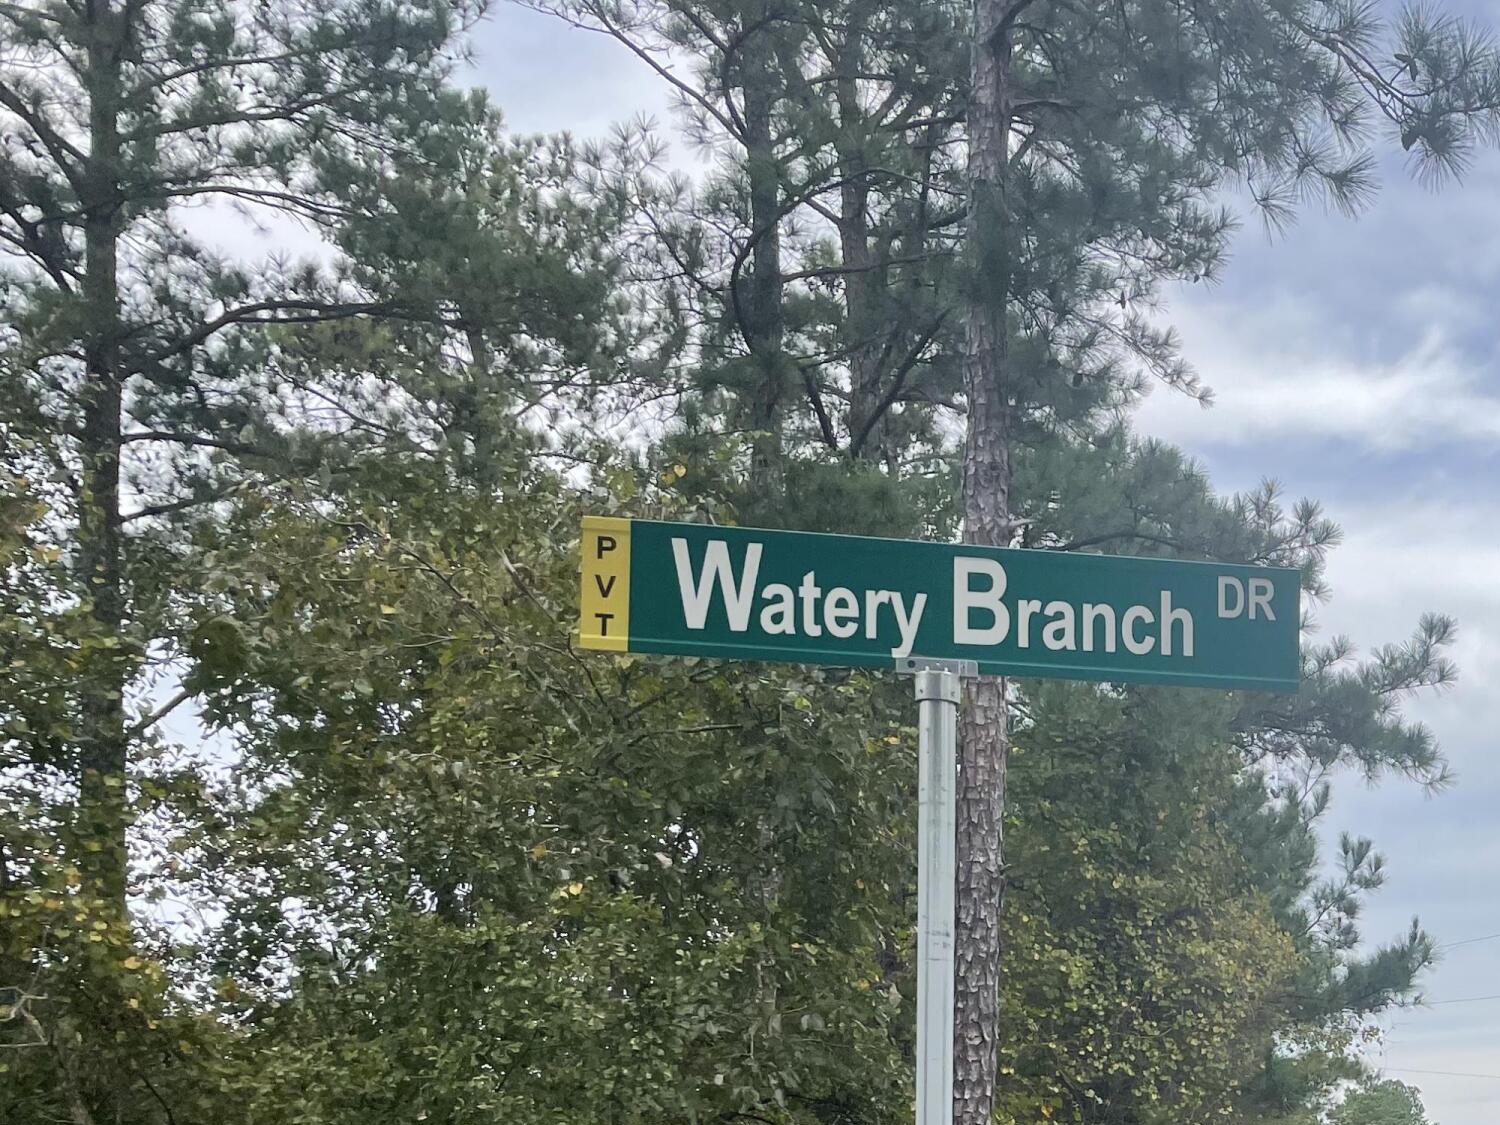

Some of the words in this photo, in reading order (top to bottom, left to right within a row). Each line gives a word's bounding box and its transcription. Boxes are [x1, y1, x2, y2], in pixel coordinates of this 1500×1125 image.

[595, 535, 618, 637] PVT
[670, 537, 927, 658] Watery
[953, 556, 1194, 657] Branch
[1217, 575, 1277, 621] DR
